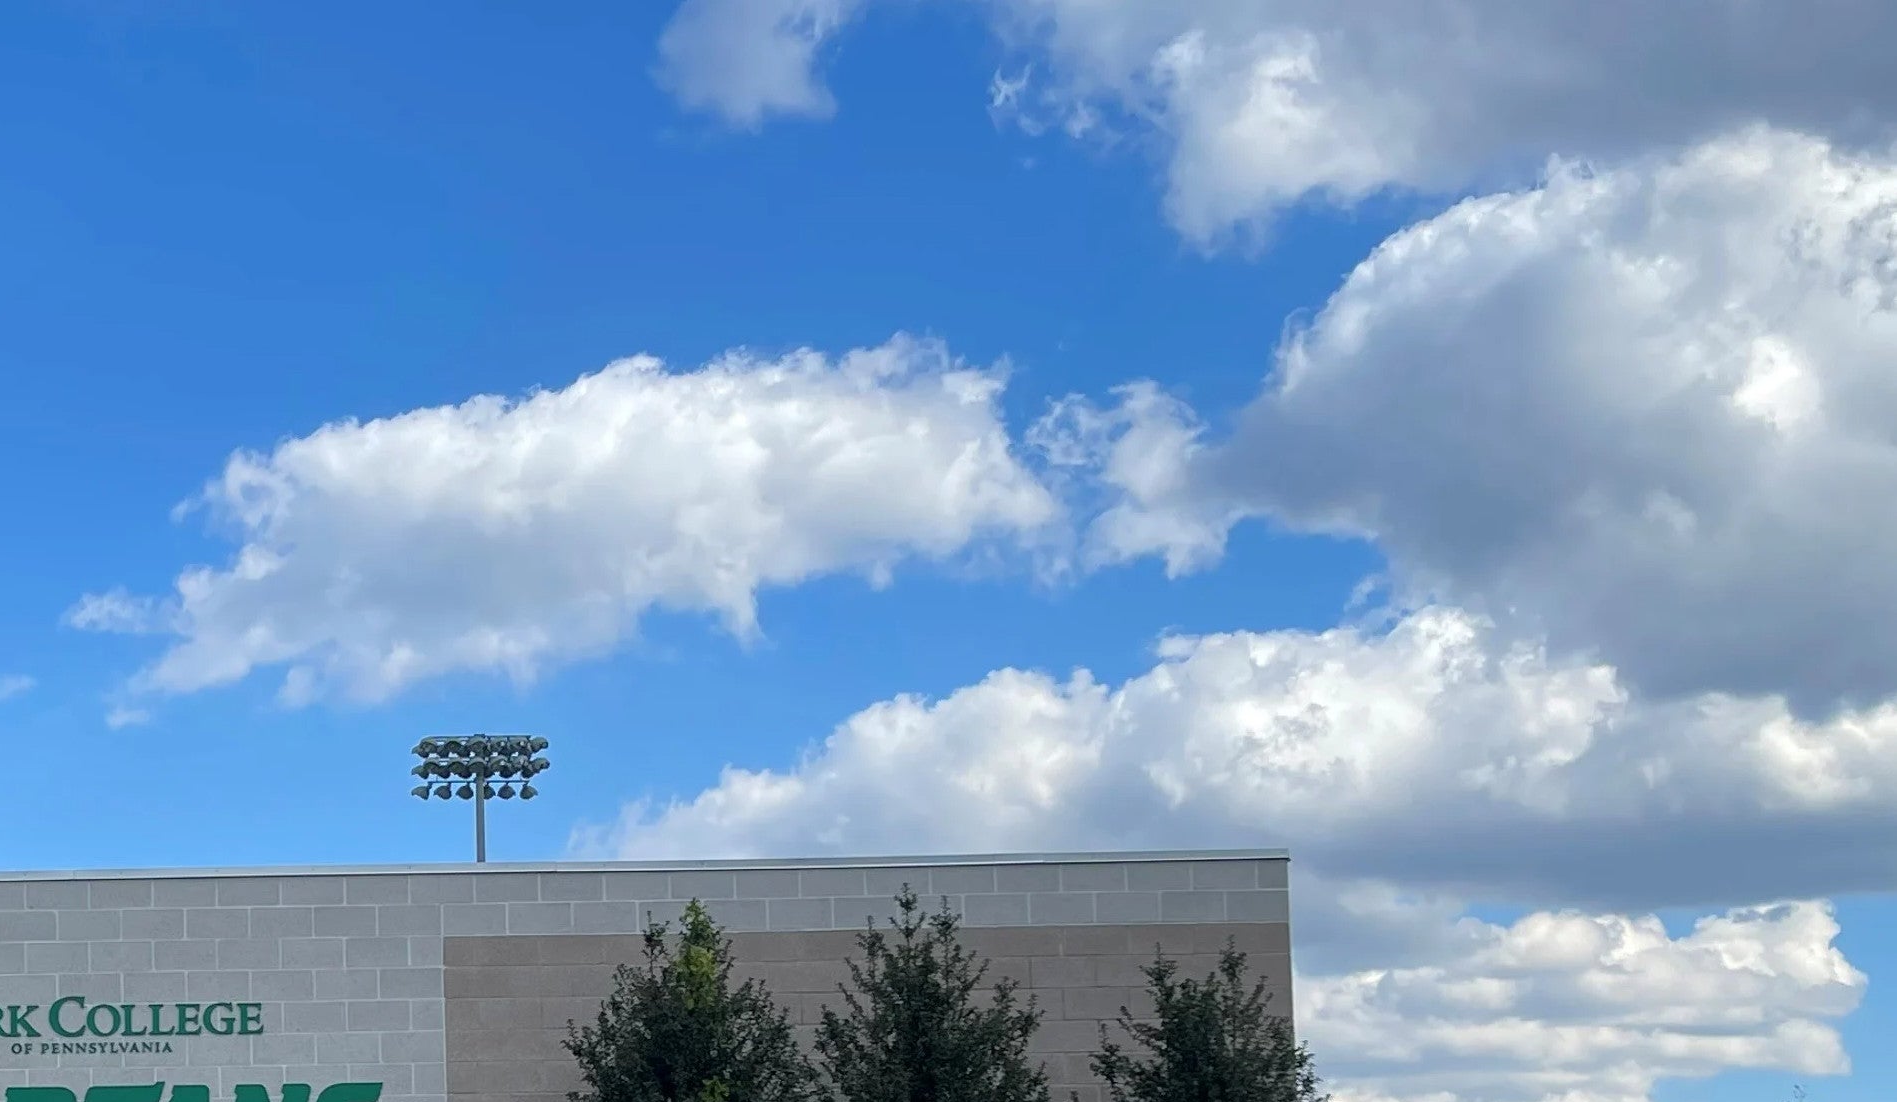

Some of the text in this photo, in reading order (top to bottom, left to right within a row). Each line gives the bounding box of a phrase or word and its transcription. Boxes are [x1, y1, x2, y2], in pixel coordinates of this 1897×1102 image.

[48, 995, 265, 1038] COLLEGE
[11, 1041, 174, 1055] OF PENNSYLVANIA
